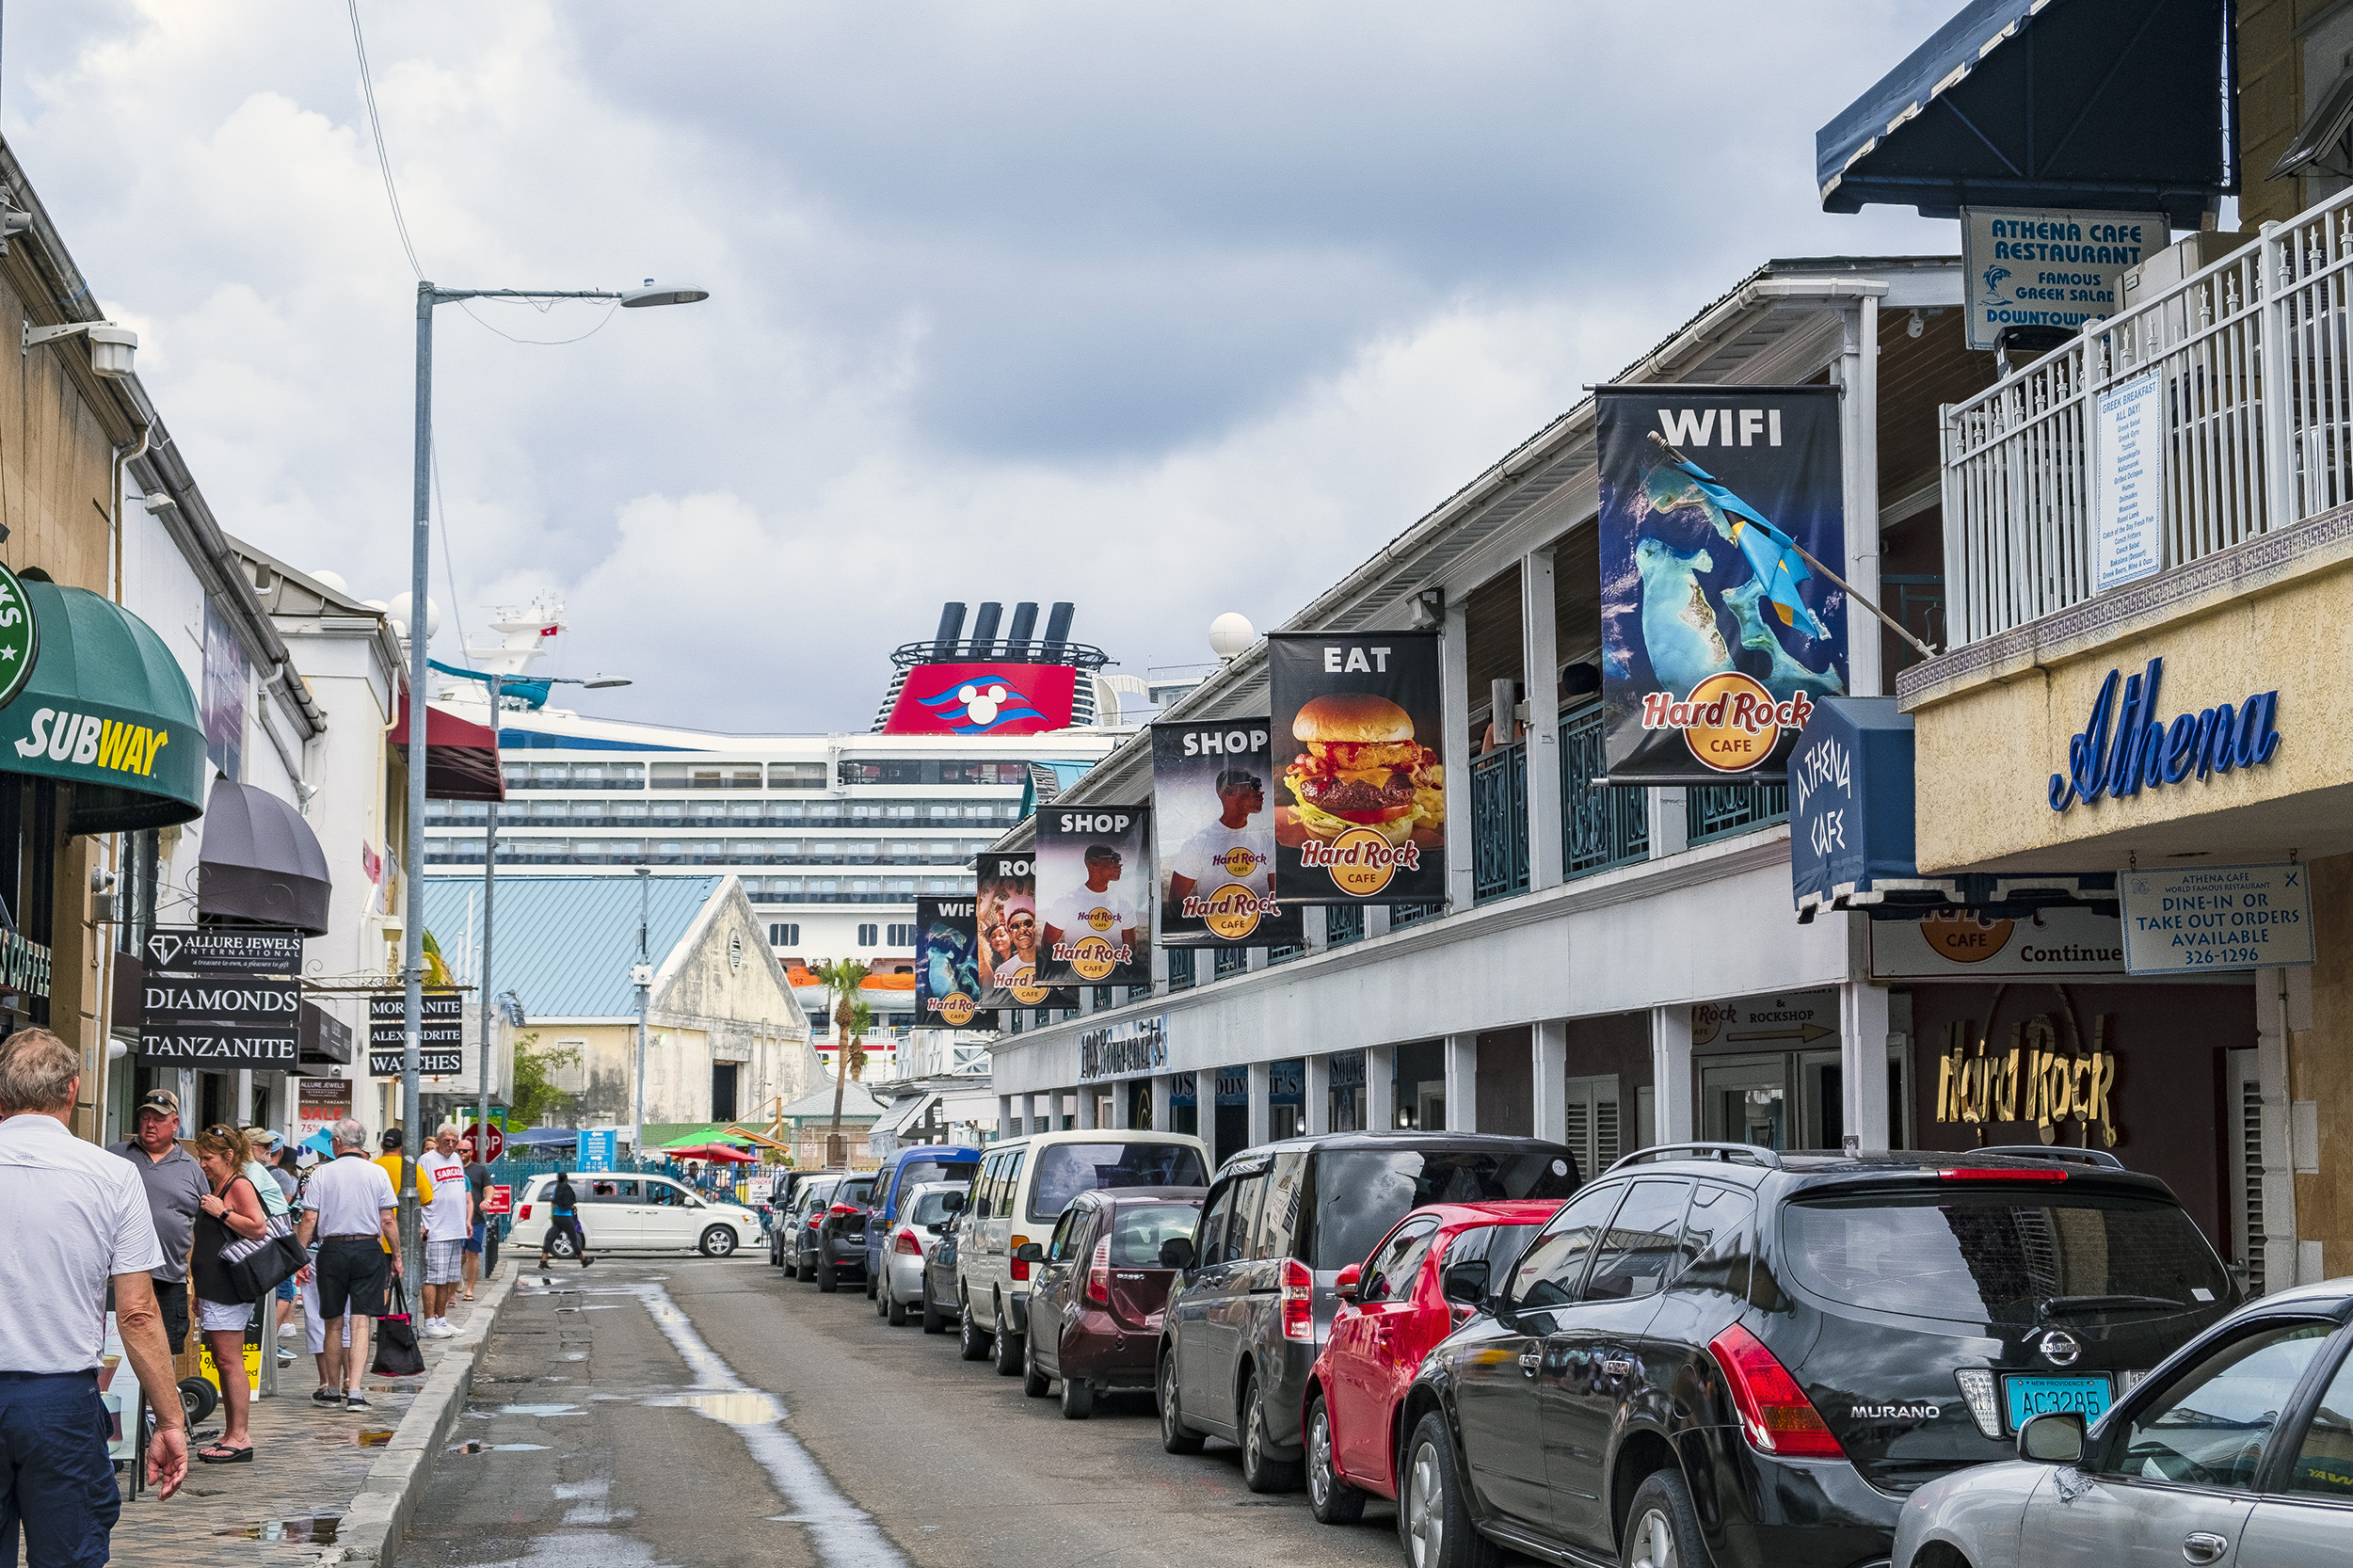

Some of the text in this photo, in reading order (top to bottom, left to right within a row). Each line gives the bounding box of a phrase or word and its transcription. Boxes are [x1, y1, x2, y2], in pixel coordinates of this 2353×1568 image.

[1992, 219, 2141, 243] ATHENA CAFE
[1995, 241, 2141, 264] RESTAURANT
[2038, 272, 2101, 285] FAMOUS
[2015, 287, 2114, 302] GREEK SALAD
[1987, 309, 2089, 326] DOWNTOWN
[2102, 381, 2156, 414] GREEK BREAKFAST
[2116, 402, 2141, 422] ALL DAY!
[1657, 409, 1782, 447] WIFI
[2118, 417, 2140, 433] Greek Salad
[2118, 433, 2129, 442] Greek
[1323, 647, 1391, 673] EAT
[1642, 690, 1815, 734] Hard Rock
[14, 708, 169, 776] SUBWAY
[2048, 656, 2280, 812] Athena
[1182, 729, 1269, 757] SHOP
[1709, 739, 1753, 753] CAFE
[1797, 735, 1851, 817] ATHENA
[1061, 814, 1129, 833] SHOP
[1811, 808, 1846, 858] CAFE
[1212, 853, 1267, 866] Hard Rock
[1301, 840, 1420, 871] Hard Rock
[1347, 873, 1377, 884] CAFE
[2183, 872, 2249, 885] ATHENA CAFE
[2192, 884, 2223, 892] FAMOUS
[2224, 882, 2271, 890] RESTAURANT
[937, 903, 977, 918] WIF
[1182, 891, 1281, 919] Hard Rock
[2162, 893, 2269, 911] DINE-IN OR
[1077, 912, 1122, 923] Hard Rock
[1220, 920, 1245, 929] CAFE
[2137, 909, 2300, 931] TAKE OUT ORDERS
[184, 936, 300, 950] ALLURE JEWELS
[1945, 933, 1988, 948] CAFE
[2171, 929, 2269, 947] AVAILABLE
[184, 948, 299, 958] INTERNATIONAL
[1052, 943, 1133, 965] Hard Rock
[2185, 947, 2259, 965] 326-1296
[9, 933, 52, 998] COFFEE
[247, 960, 271, 968] pleasure
[993, 973, 1031, 988] Hard
[144, 988, 298, 1013] DIAMONDS
[371, 1000, 460, 1015] MORNITE
[927, 998, 958, 1012] Hard
[1776, 999, 1786, 1008] &
[1699, 1003, 1815, 1025] Rock ROCKSHOP
[371, 1030, 460, 1042] ALEXDRITE
[1694, 1028, 1708, 1036] AFE
[142, 1035, 295, 1059] TANZANITE
[371, 1054, 460, 1071] WACHES
[1936, 1014, 2118, 1148] Hard Rock
[301, 1106, 343, 1121] SALE
[301, 1124, 322, 1133] 75%
[1850, 1405, 1941, 1419] MURANO
[2023, 1391, 2100, 1416] AC3285
